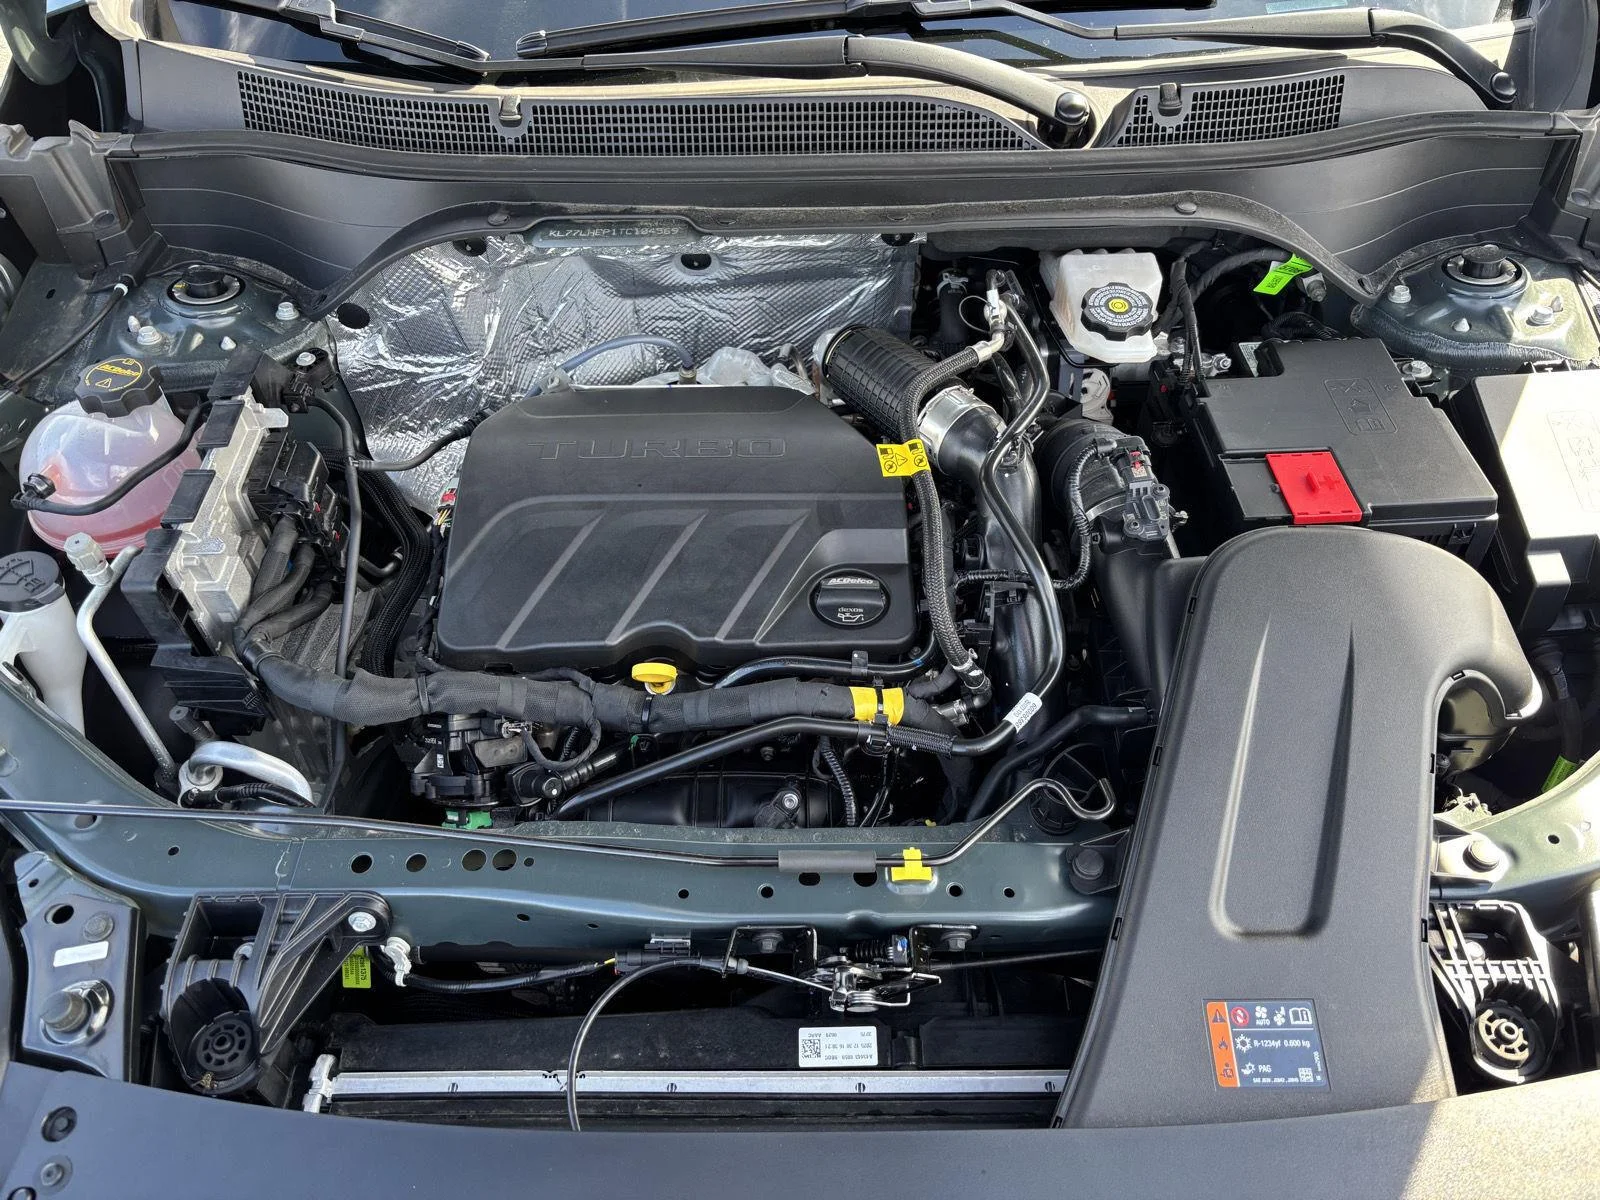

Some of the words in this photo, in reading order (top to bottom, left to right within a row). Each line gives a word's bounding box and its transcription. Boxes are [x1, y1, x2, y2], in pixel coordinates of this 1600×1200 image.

[528, 439, 786, 460] TURBO
[827, 577, 873, 585] ACDelco
[1256, 1018, 1270, 1026] AUTO
[1253, 1039, 1281, 1048] R-1234yf
[1301, 1040, 1310, 1048] kg
[1258, 1064, 1272, 1072] PAG
